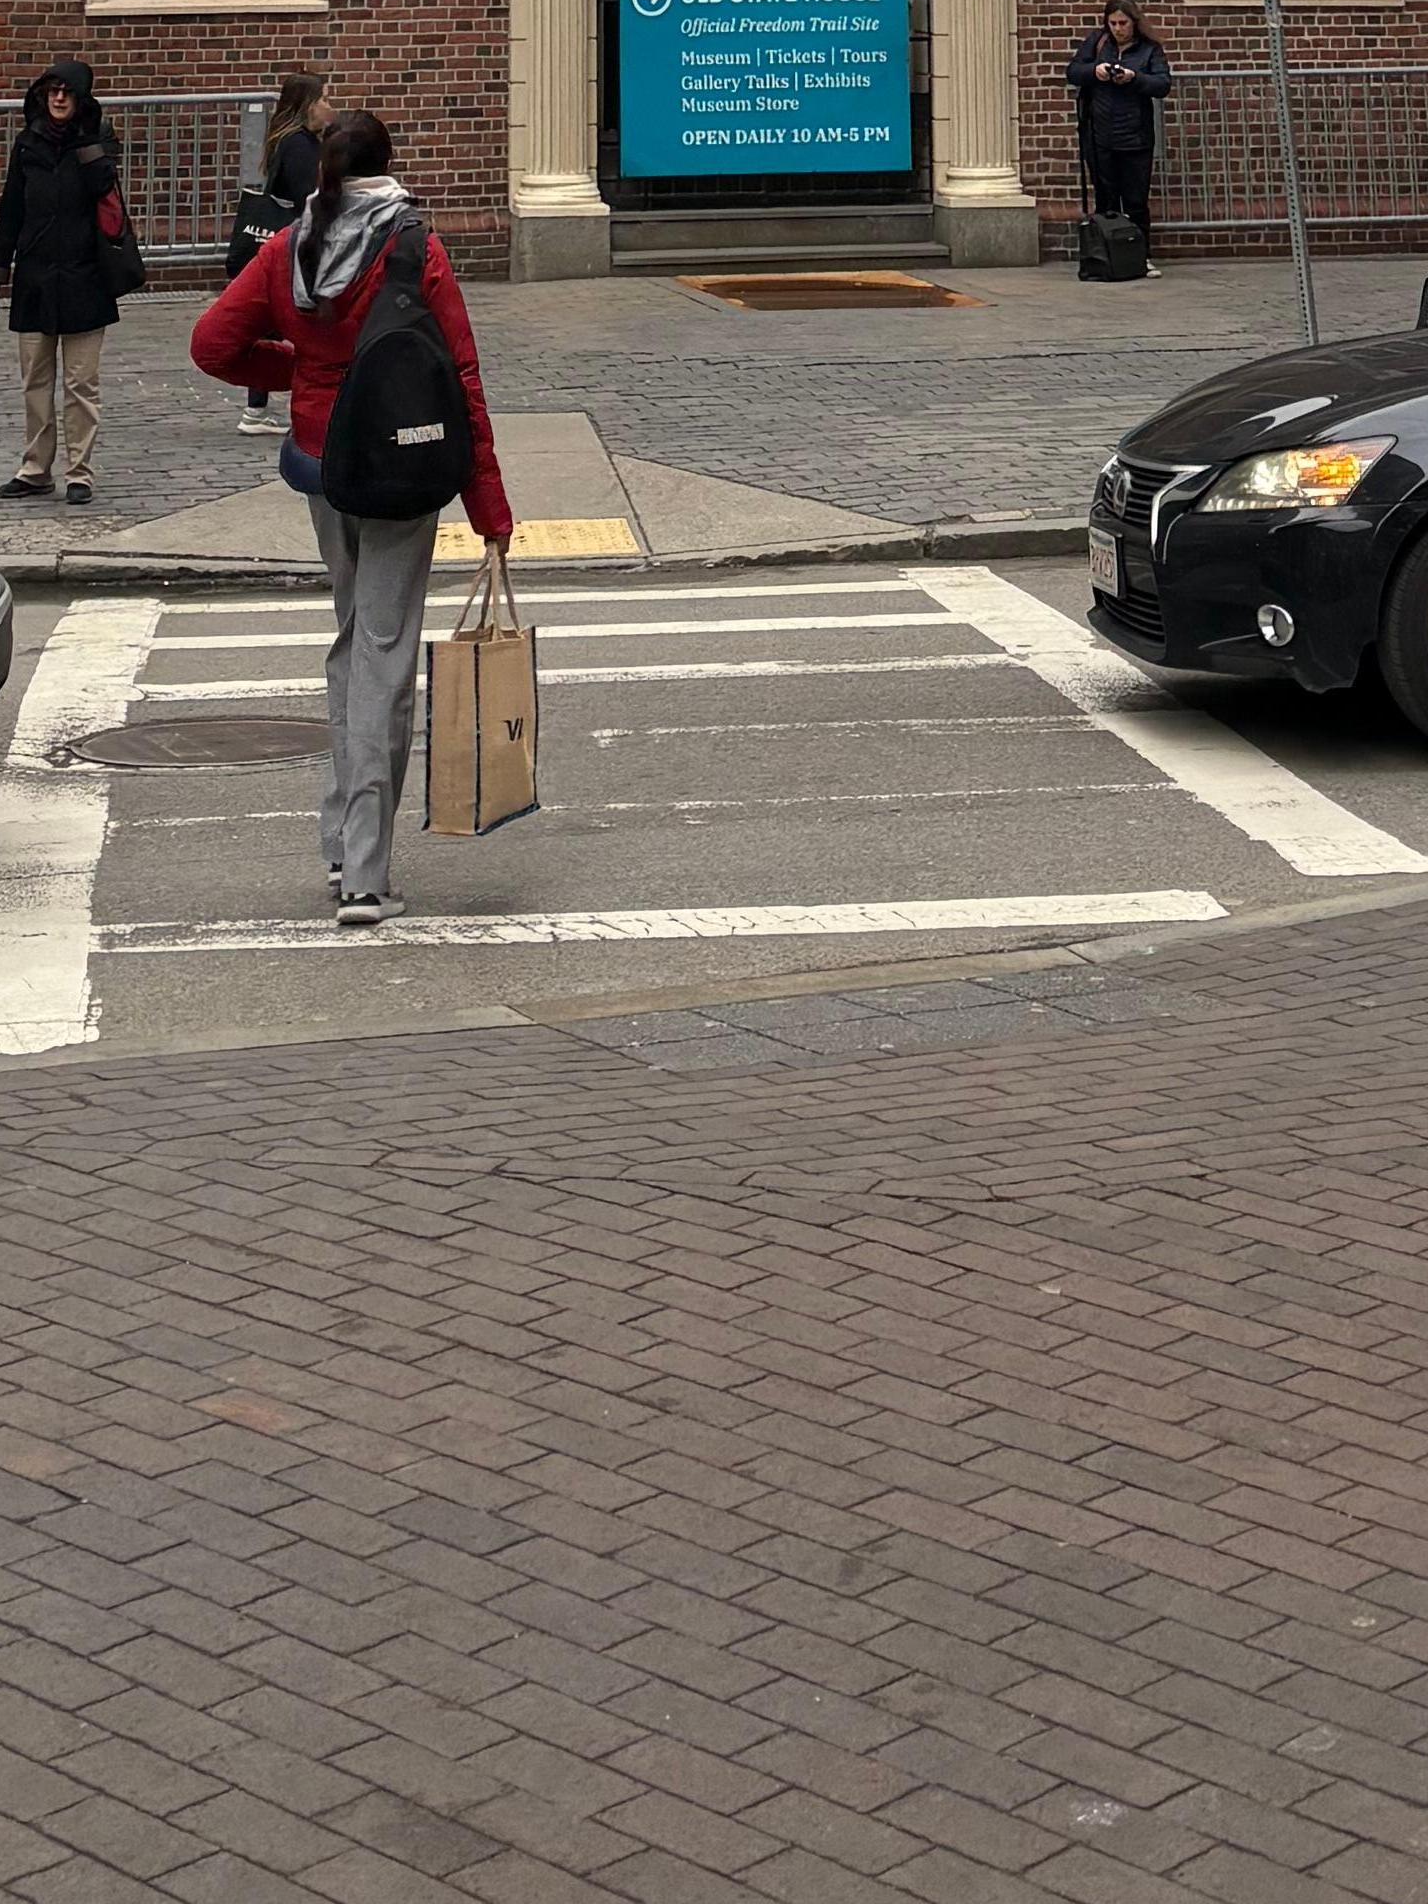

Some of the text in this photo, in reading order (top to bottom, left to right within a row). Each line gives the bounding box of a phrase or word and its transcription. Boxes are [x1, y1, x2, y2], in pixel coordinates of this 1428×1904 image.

[680, 15, 880, 37] Official Freedom Trail Site
[681, 48, 888, 66] Museum Tickets Tours
[681, 72, 872, 93] Gallery Talks Exhibits
[681, 96, 800, 113] Museum Store
[681, 129, 731, 146] OPEN
[735, 128, 787, 144] DAILY
[791, 127, 812, 143] 10
[863, 126, 891, 142] PM
